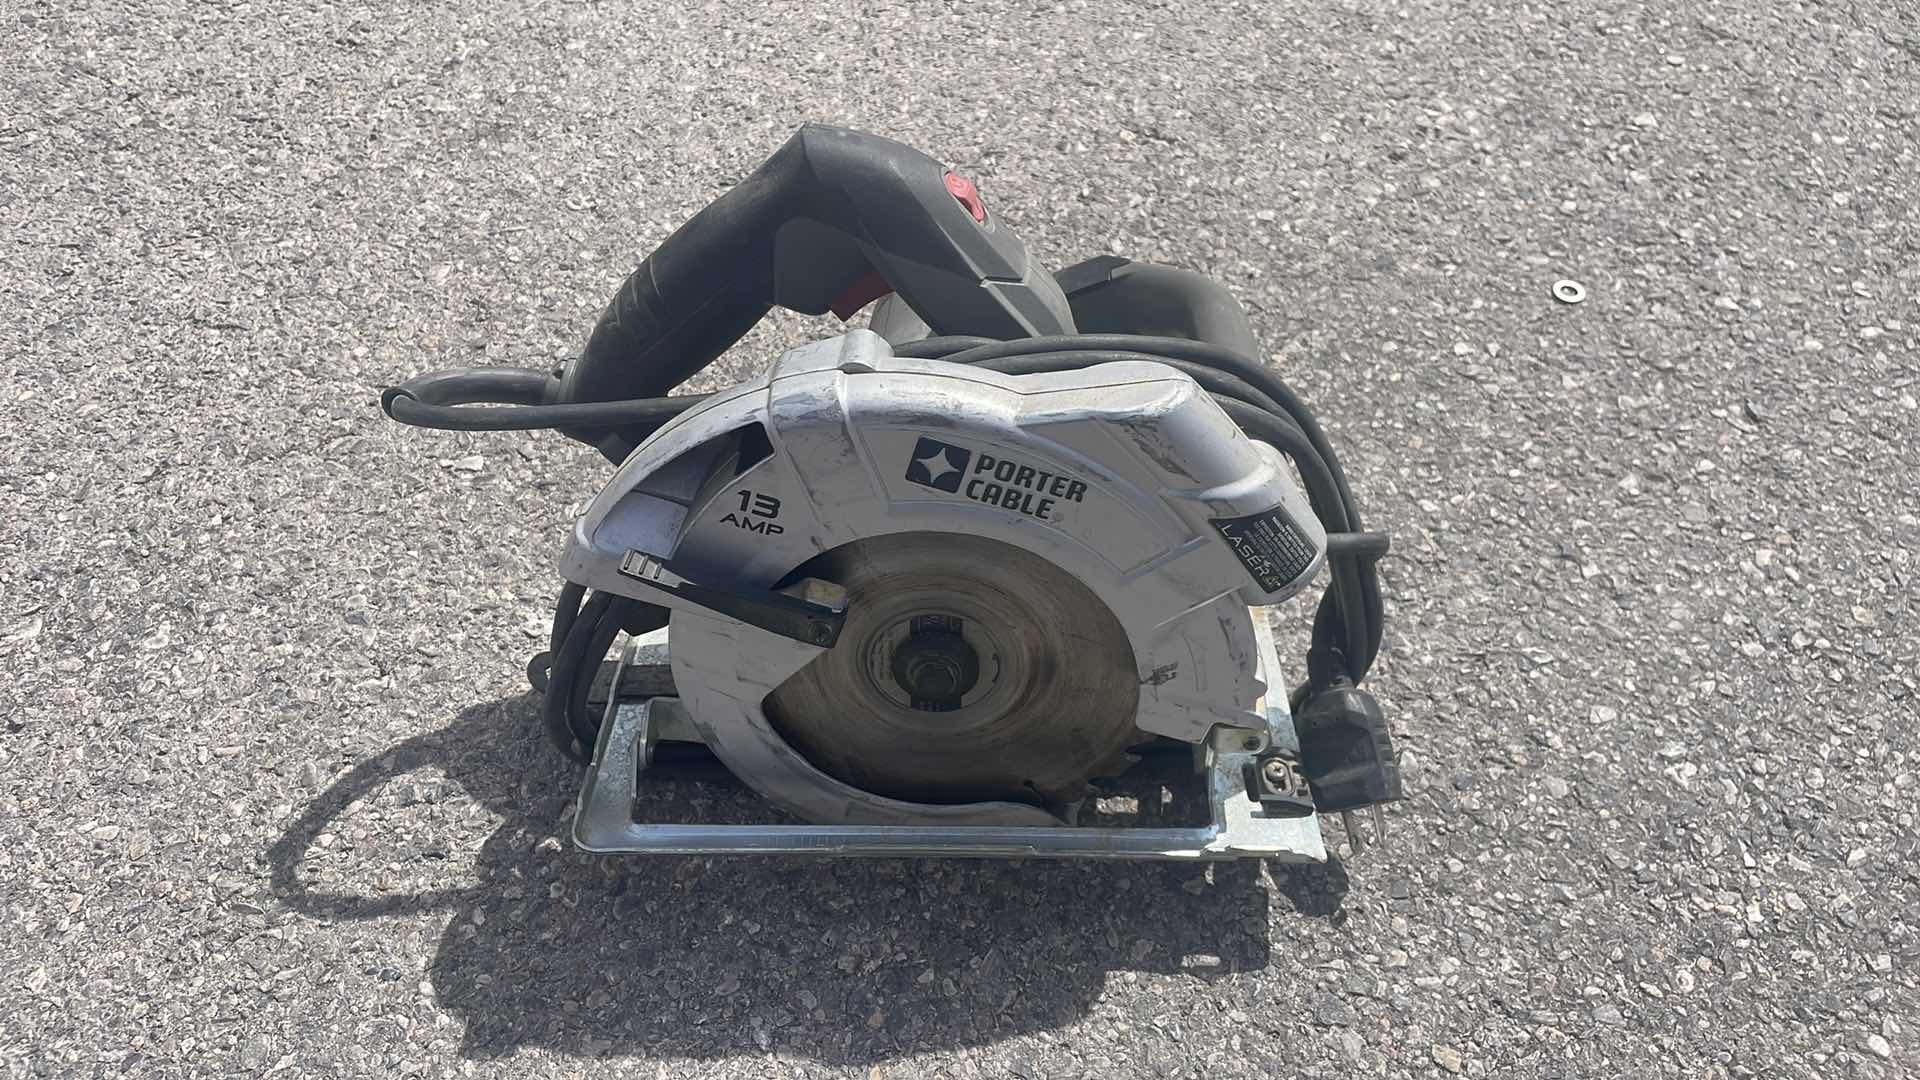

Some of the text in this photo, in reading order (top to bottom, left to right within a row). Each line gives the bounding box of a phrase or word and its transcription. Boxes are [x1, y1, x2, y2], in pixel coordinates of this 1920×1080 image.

[974, 454, 1088, 503] PORTER
[738, 489, 781, 519] 13
[966, 479, 1055, 520] CABLE
[720, 513, 784, 536] AMP
[1221, 524, 1270, 577] LASER
